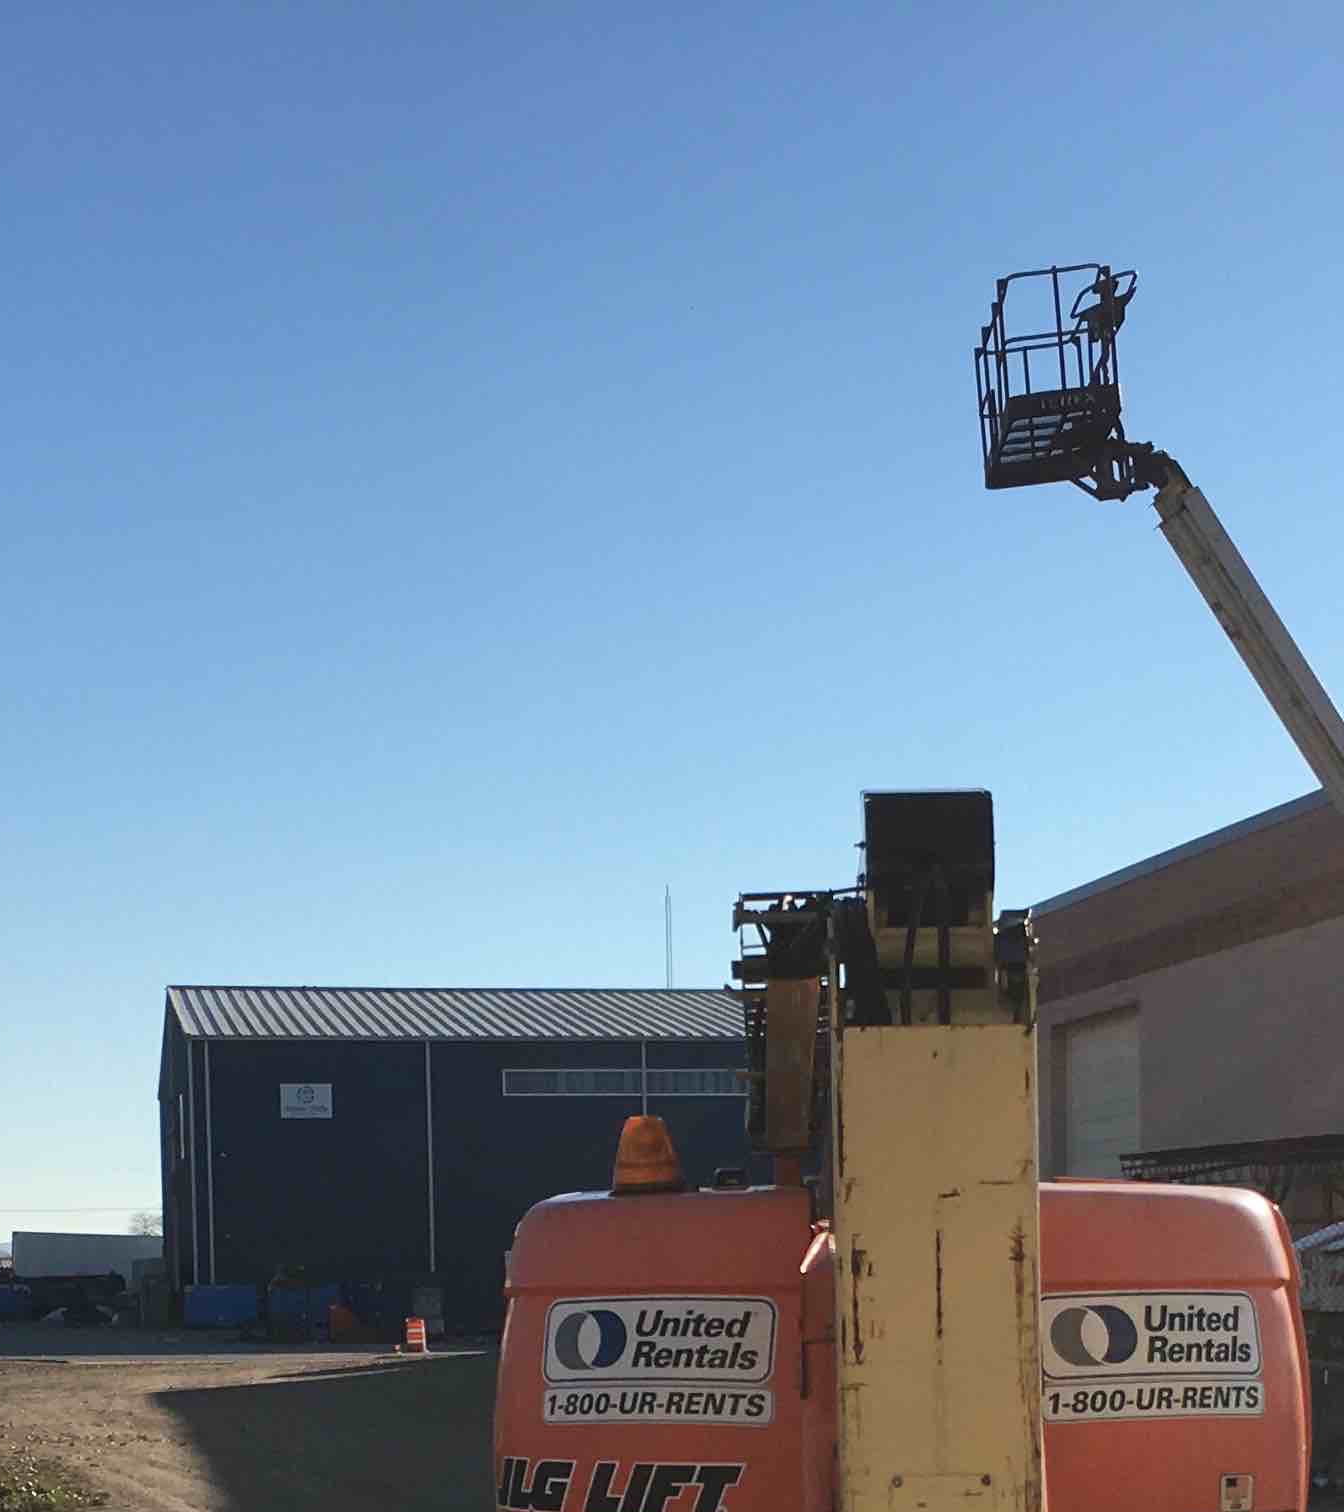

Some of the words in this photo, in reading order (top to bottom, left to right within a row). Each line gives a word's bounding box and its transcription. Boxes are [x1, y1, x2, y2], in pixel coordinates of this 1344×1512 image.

[636, 1310, 752, 1338] United
[1144, 1305, 1240, 1332] United
[631, 1341, 759, 1370] Rentals
[1147, 1336, 1252, 1363] Rentals
[547, 1392, 766, 1417] 1-800-UR-RENTS
[1048, 1386, 1259, 1414] 1-800-UR-RENTS
